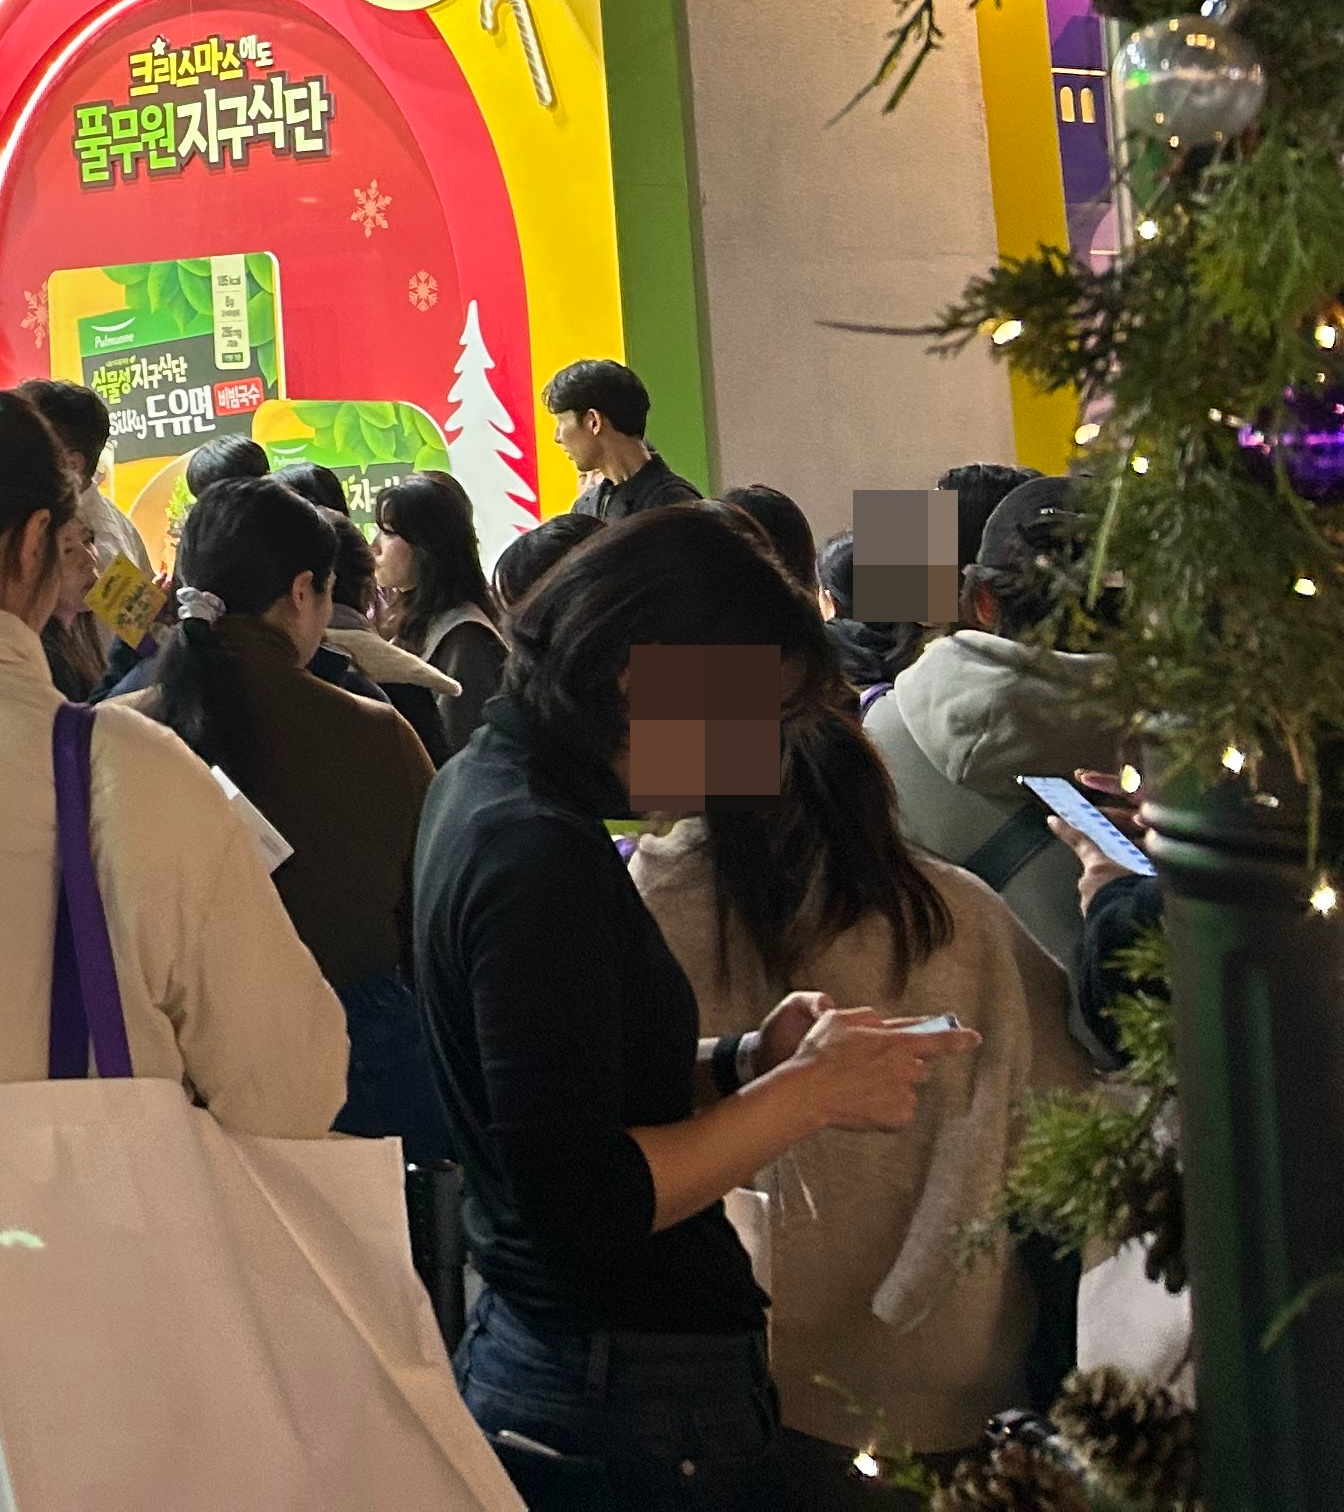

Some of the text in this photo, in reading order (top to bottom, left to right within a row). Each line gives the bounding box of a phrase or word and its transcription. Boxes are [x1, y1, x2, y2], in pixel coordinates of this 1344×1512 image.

[129, 34, 274, 97] 크리스마스에도
[75, 77, 328, 182] 풀무원지구식단
[109, 385, 216, 440] Silky 두유면
[217, 384, 262, 409] 비빔국수
